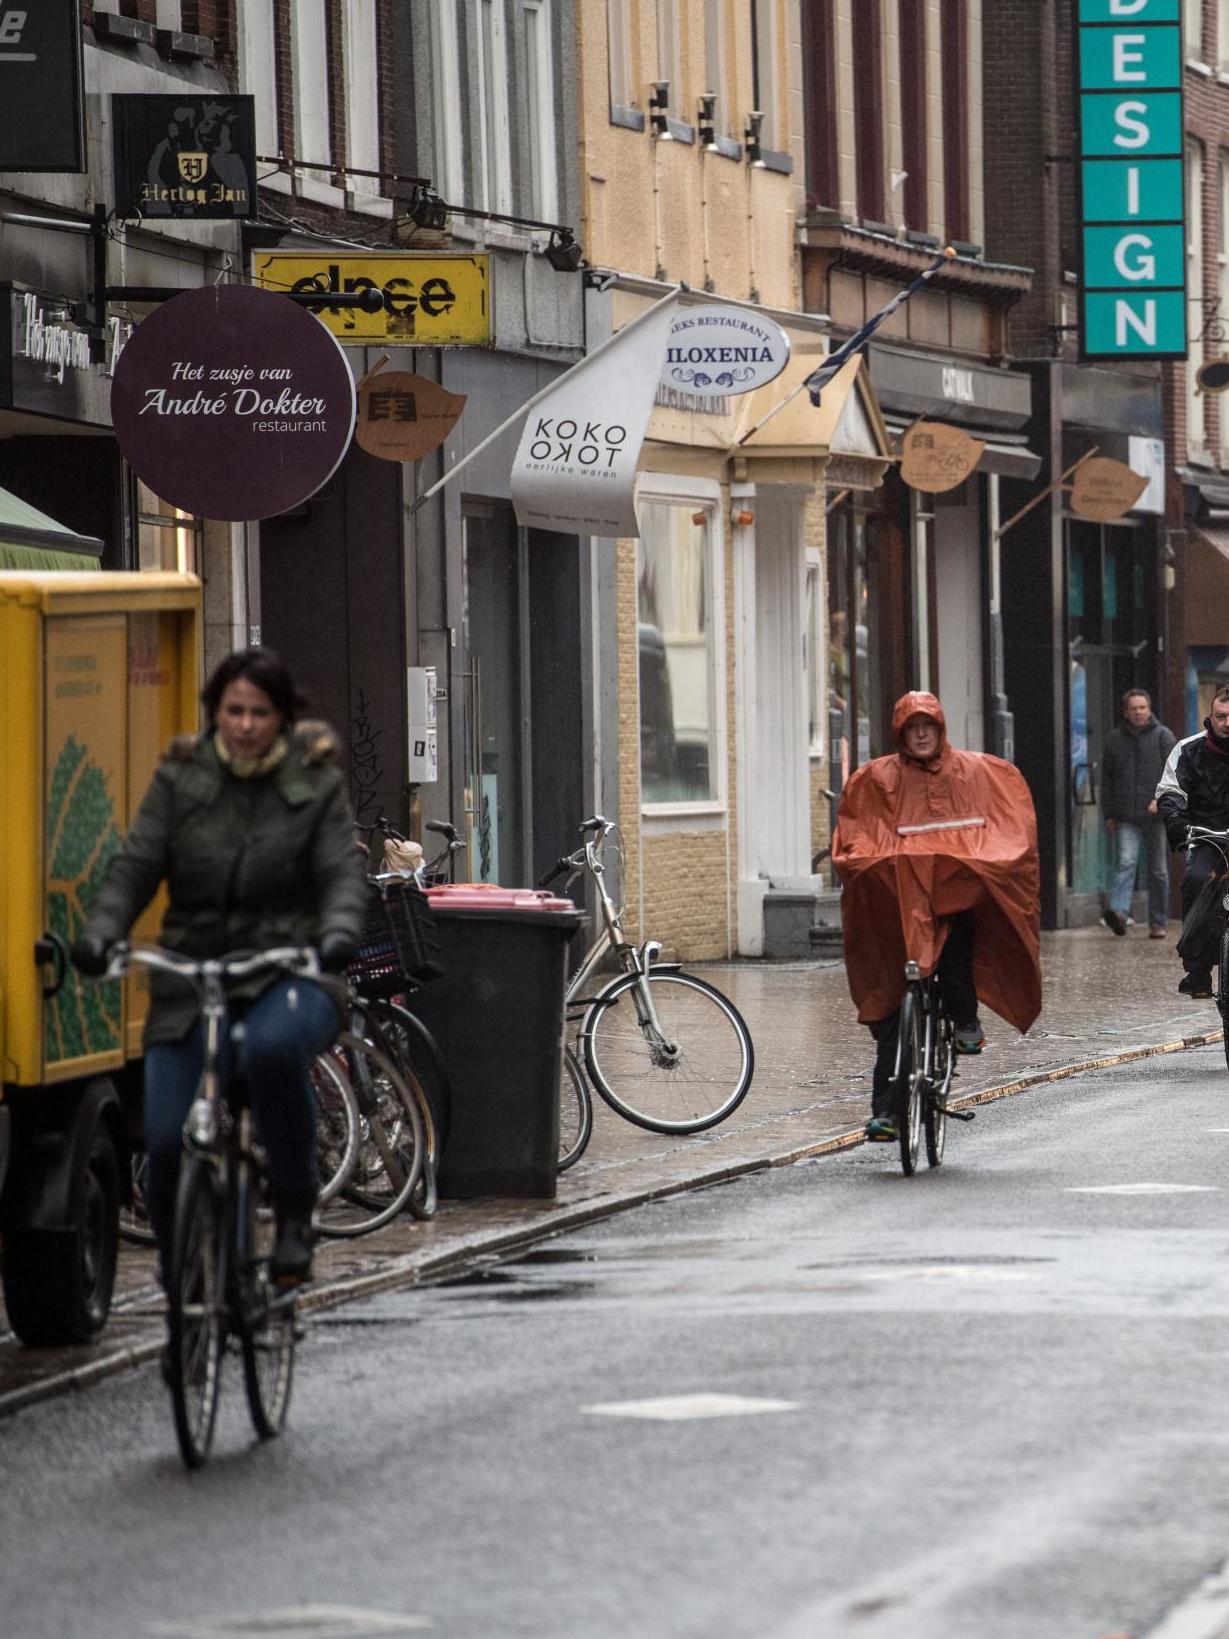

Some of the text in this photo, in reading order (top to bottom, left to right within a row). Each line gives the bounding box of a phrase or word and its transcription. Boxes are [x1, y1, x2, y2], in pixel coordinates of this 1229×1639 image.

[141, 182, 248, 205] Hertog Jan
[697, 317, 771, 342] RESTAURANT
[172, 362, 293, 385] Het zusje van
[138, 387, 326, 415] André Dokter
[253, 420, 327, 432] restaurant
[535, 418, 627, 444] KOKO
[526, 463, 617, 478] eerlijke waren
